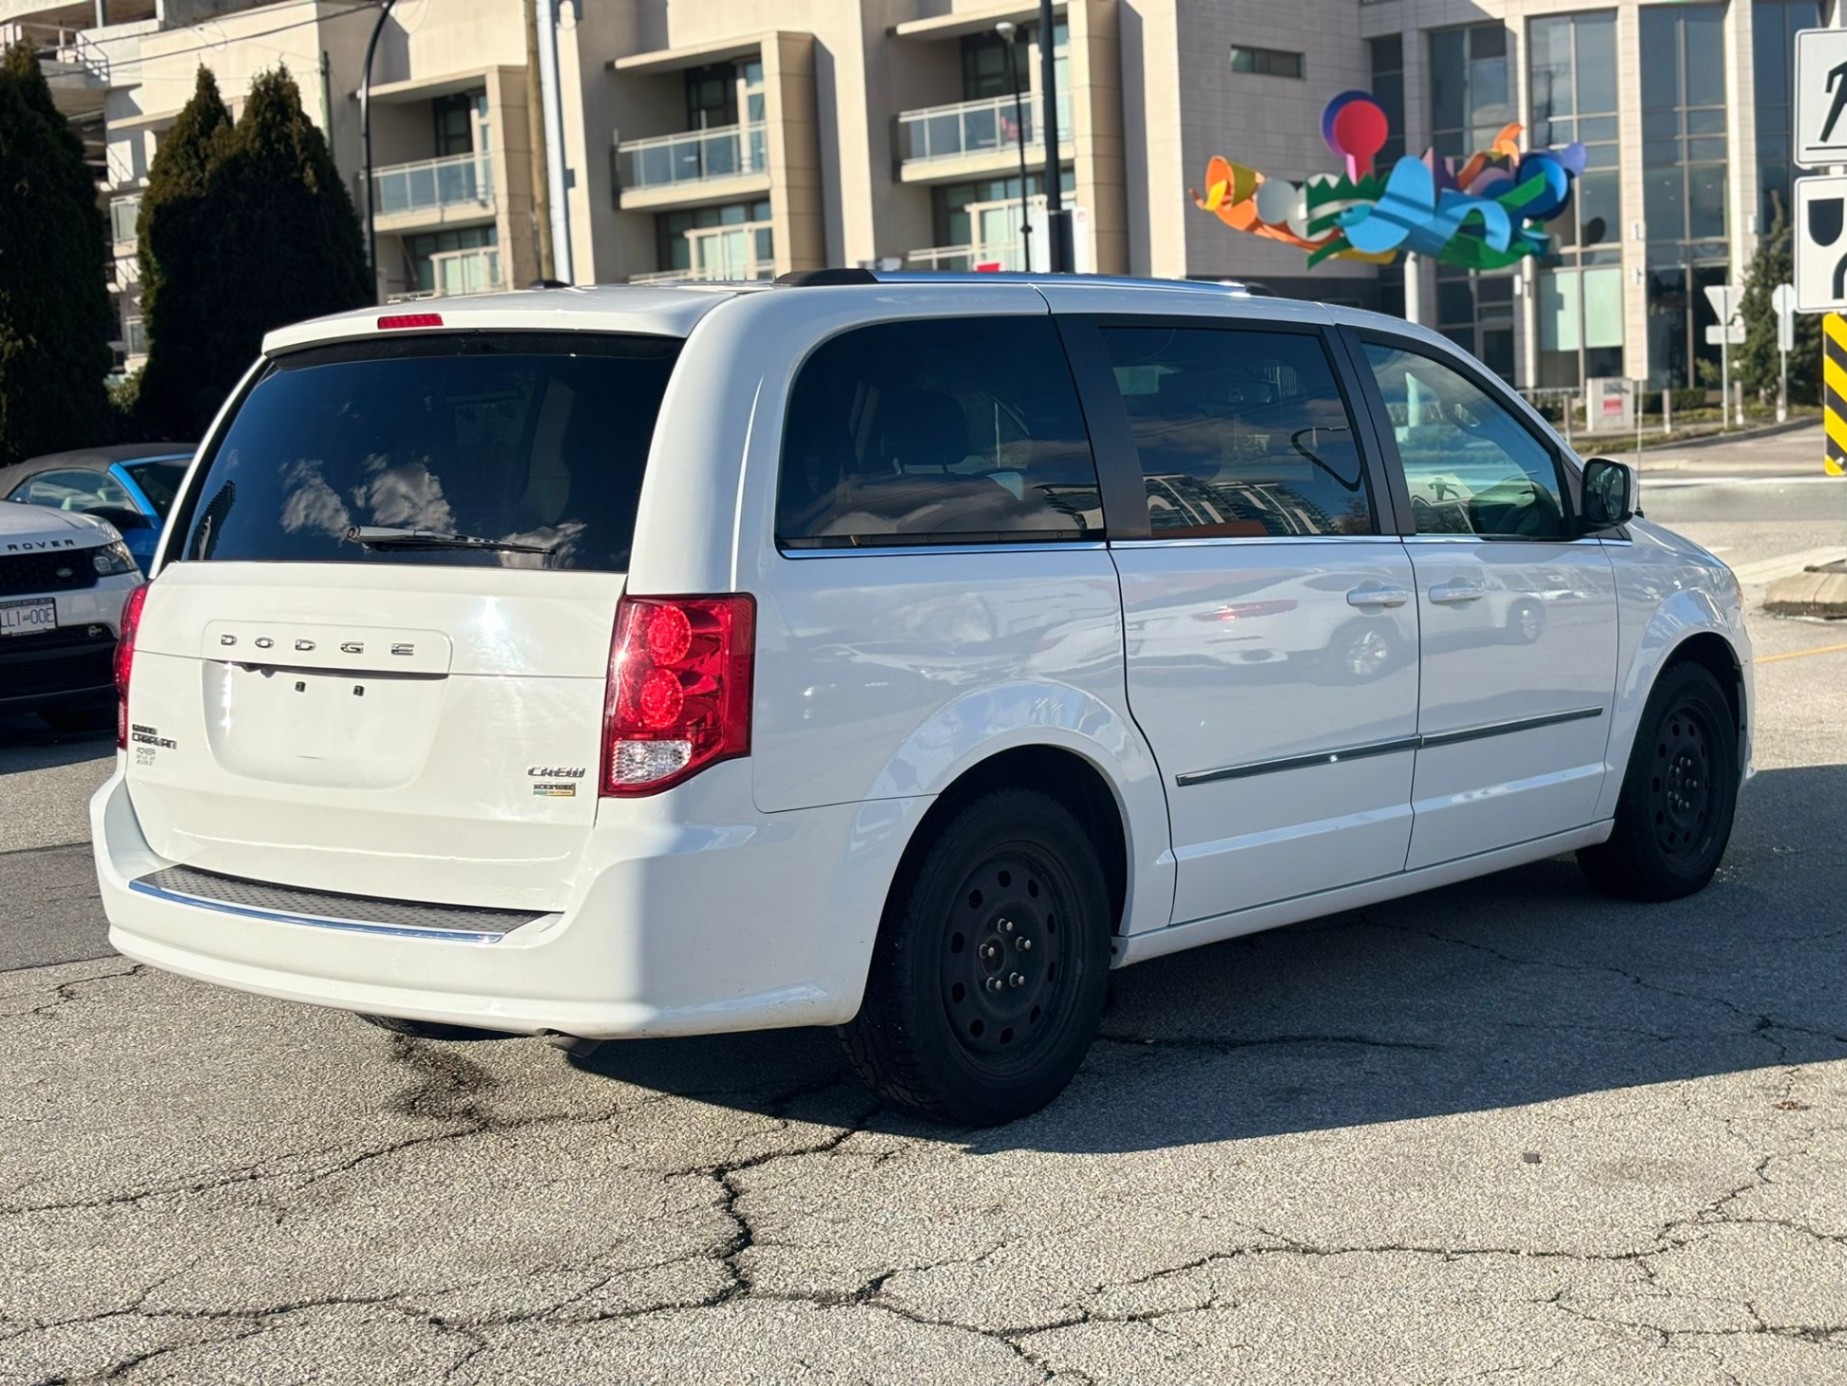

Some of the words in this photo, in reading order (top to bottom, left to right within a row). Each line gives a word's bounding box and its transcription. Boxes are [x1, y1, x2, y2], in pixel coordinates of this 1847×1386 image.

[7, 539, 75, 551] ROVER
[220, 634, 415, 656] DODGE
[132, 732, 178, 750] CARAVAN
[527, 767, 586, 778] CREW
